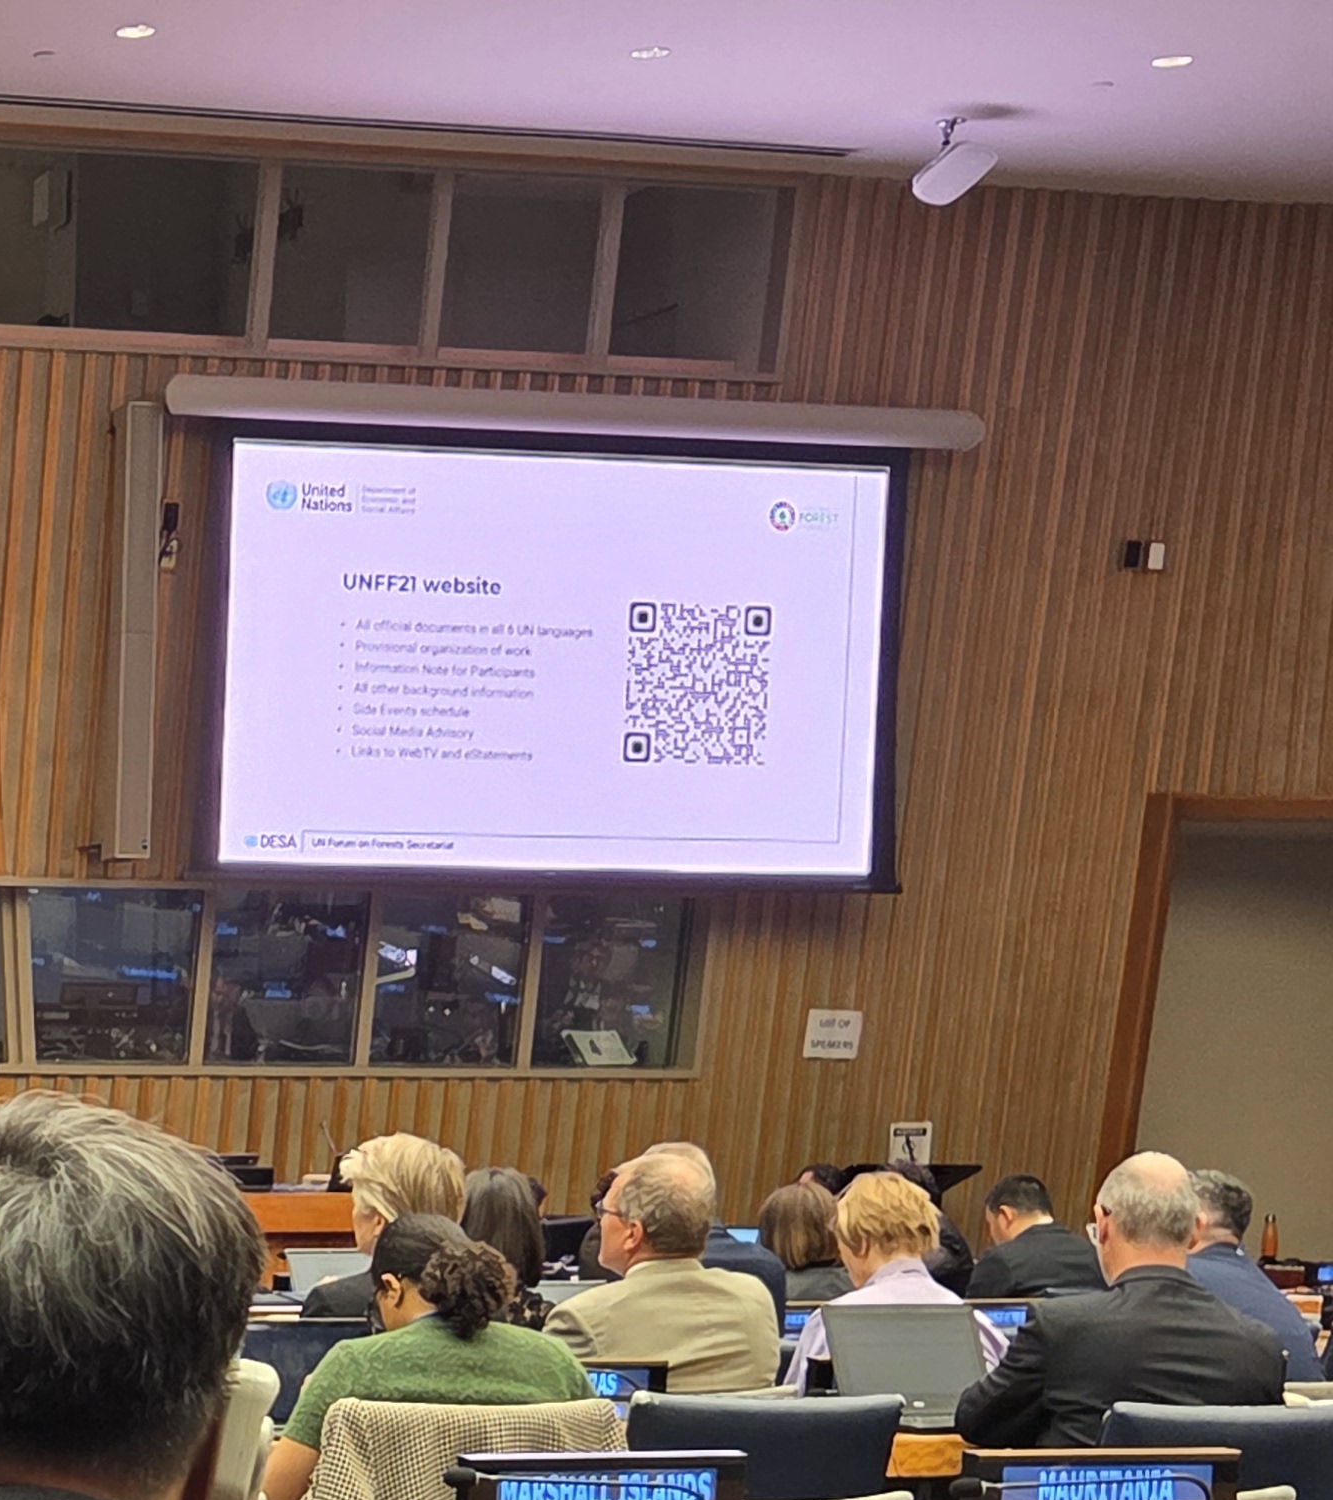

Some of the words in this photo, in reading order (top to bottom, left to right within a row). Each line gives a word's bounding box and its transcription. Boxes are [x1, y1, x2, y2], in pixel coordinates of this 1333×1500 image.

[301, 483, 345, 498] United
[301, 498, 352, 512] Nations
[343, 573, 417, 592] UNFF21
[423, 576, 501, 595] website
[414, 622, 476, 634] documents
[537, 625, 593, 639] languages
[355, 640, 417, 654] Provisional
[470, 665, 535, 679] Participants
[402, 684, 468, 698] background
[471, 686, 534, 698] information
[260, 835, 297, 848] DESA
